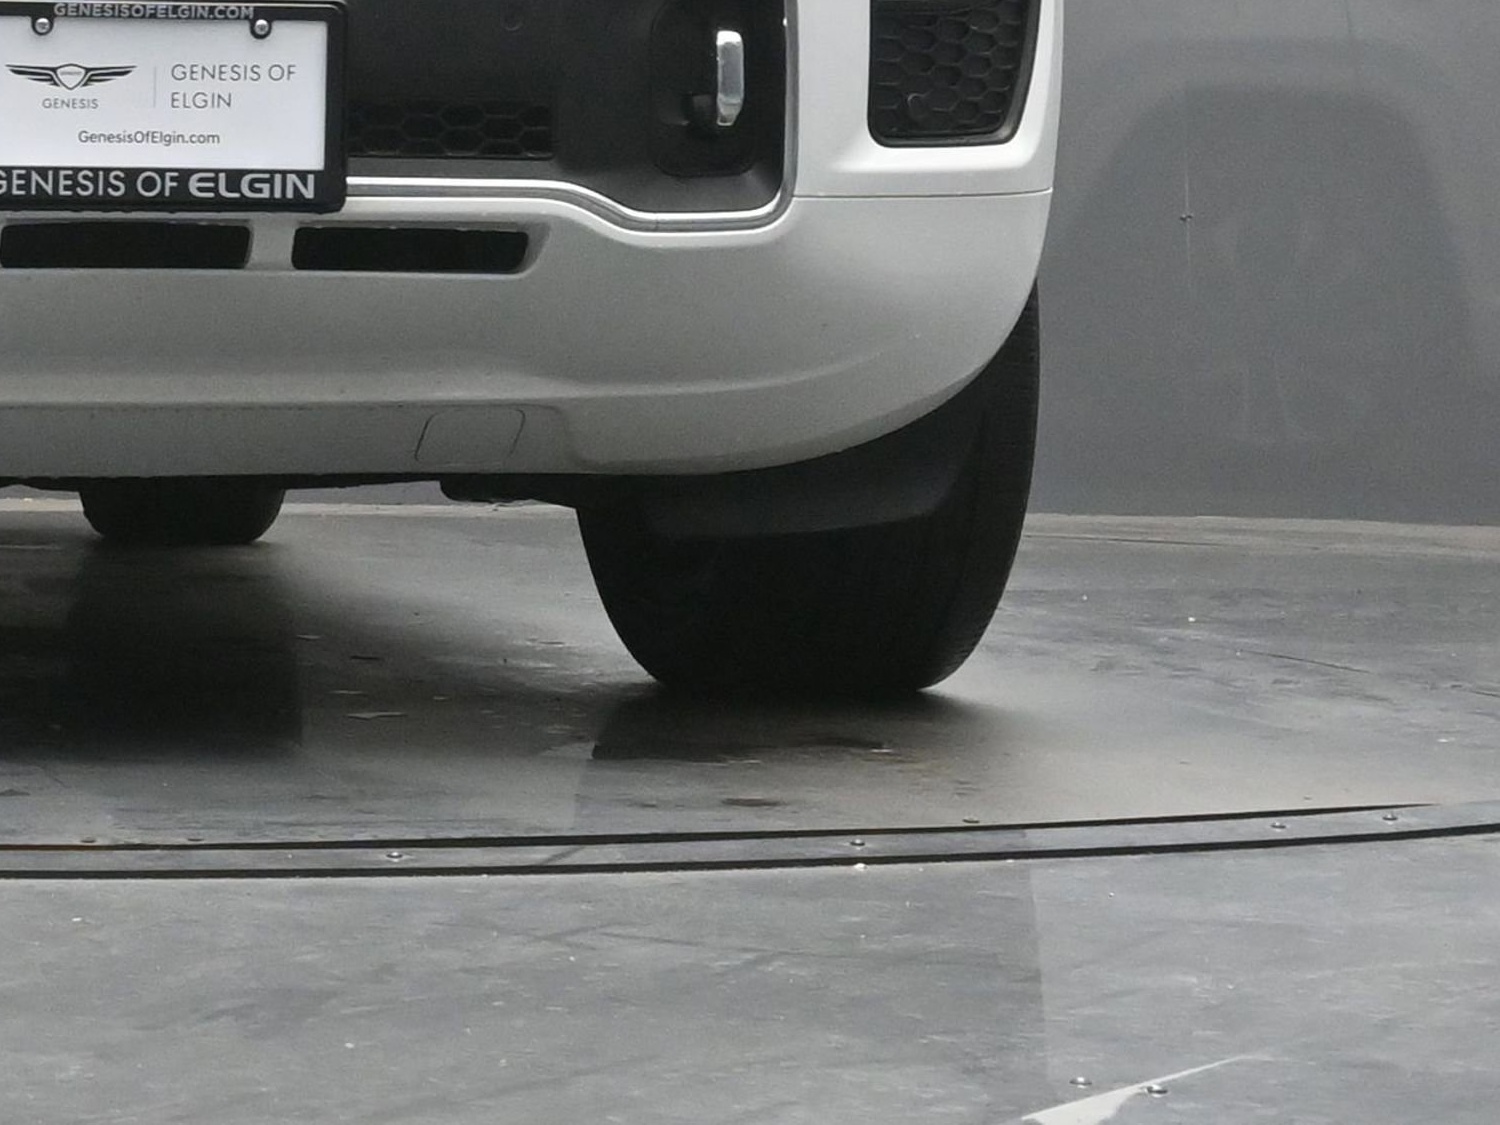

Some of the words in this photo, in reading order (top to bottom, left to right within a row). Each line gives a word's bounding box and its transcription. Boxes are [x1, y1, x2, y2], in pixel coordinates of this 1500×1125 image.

[54, 2, 254, 20] GENESISOFELGIN.COM
[171, 63, 260, 82] GENESIS
[267, 64, 297, 82] OF
[41, 97, 99, 110] GENESIS
[170, 91, 233, 110] ELGIN
[77, 129, 221, 147] GenesisOfElgin.com
[136, 171, 180, 198] OF
[187, 171, 315, 200] ELGIN
